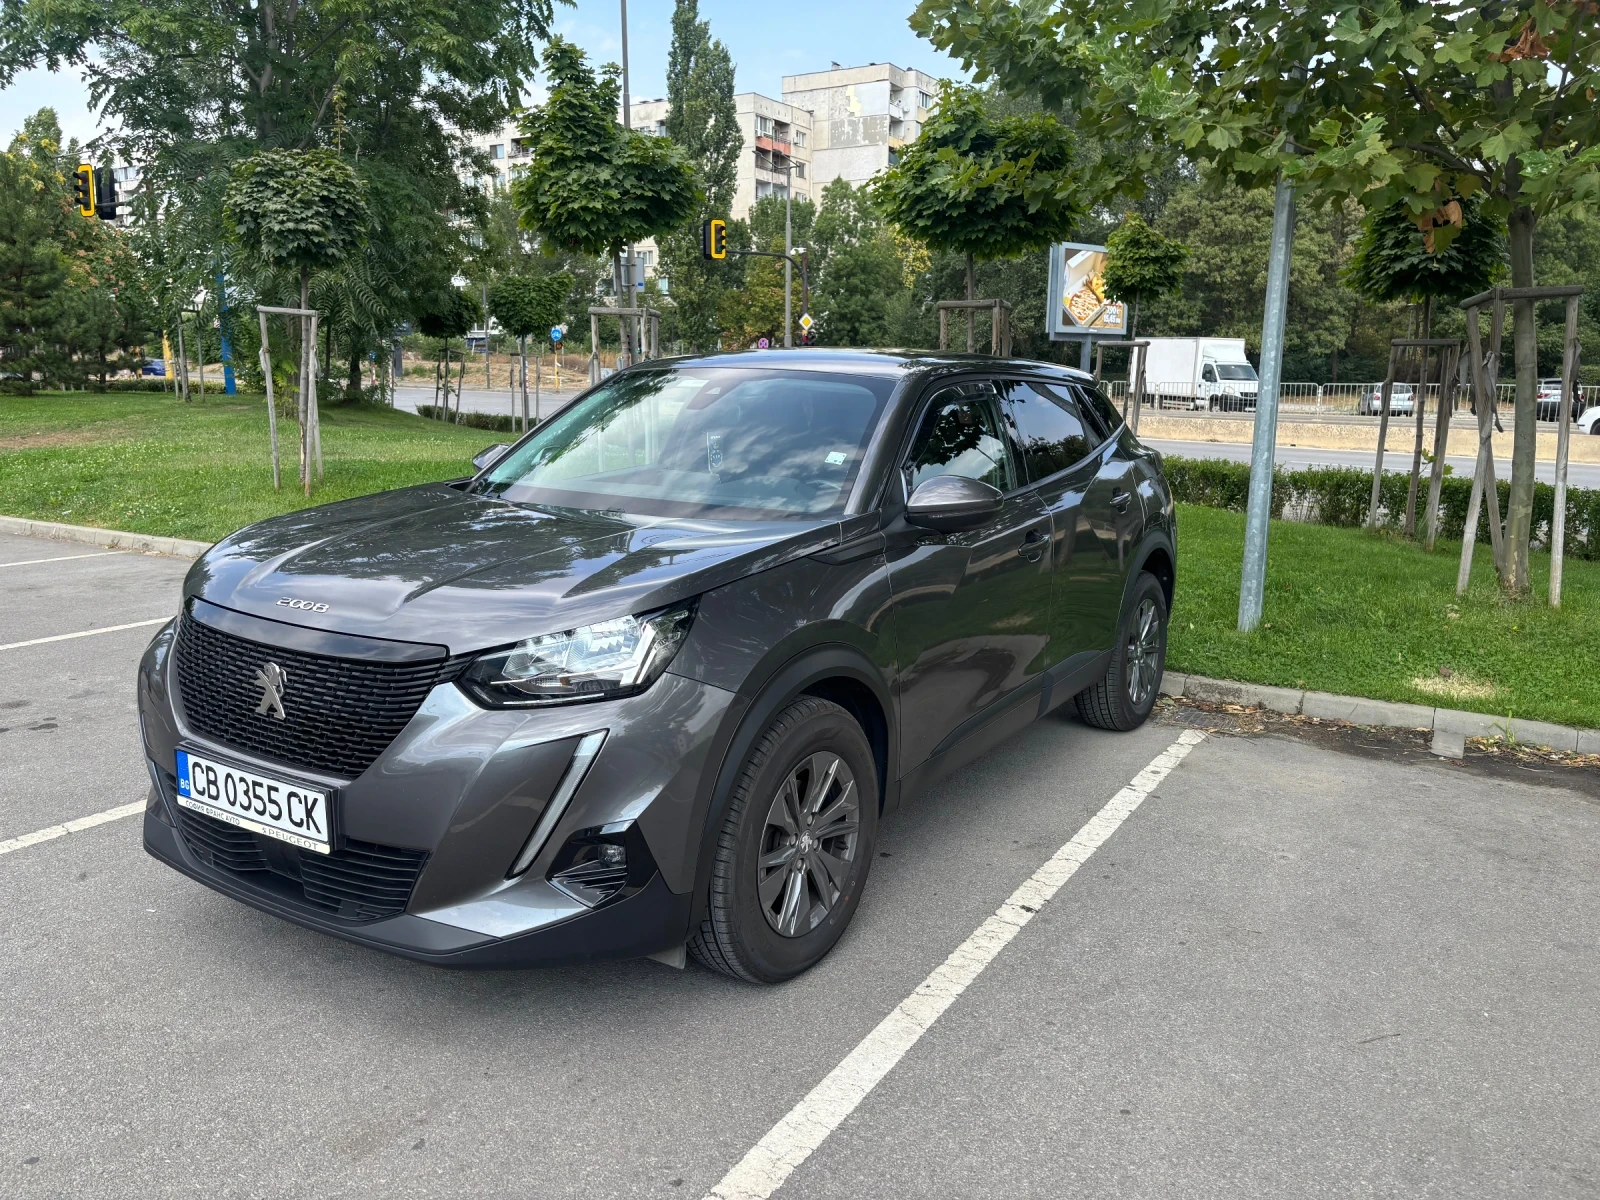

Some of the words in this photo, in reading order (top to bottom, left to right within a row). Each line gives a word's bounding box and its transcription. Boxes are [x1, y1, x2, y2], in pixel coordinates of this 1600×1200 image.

[276, 597, 329, 613] 2008
[180, 778, 190, 790] BG
[224, 772, 283, 821] 0355
[268, 828, 318, 850] PEUGEOT
